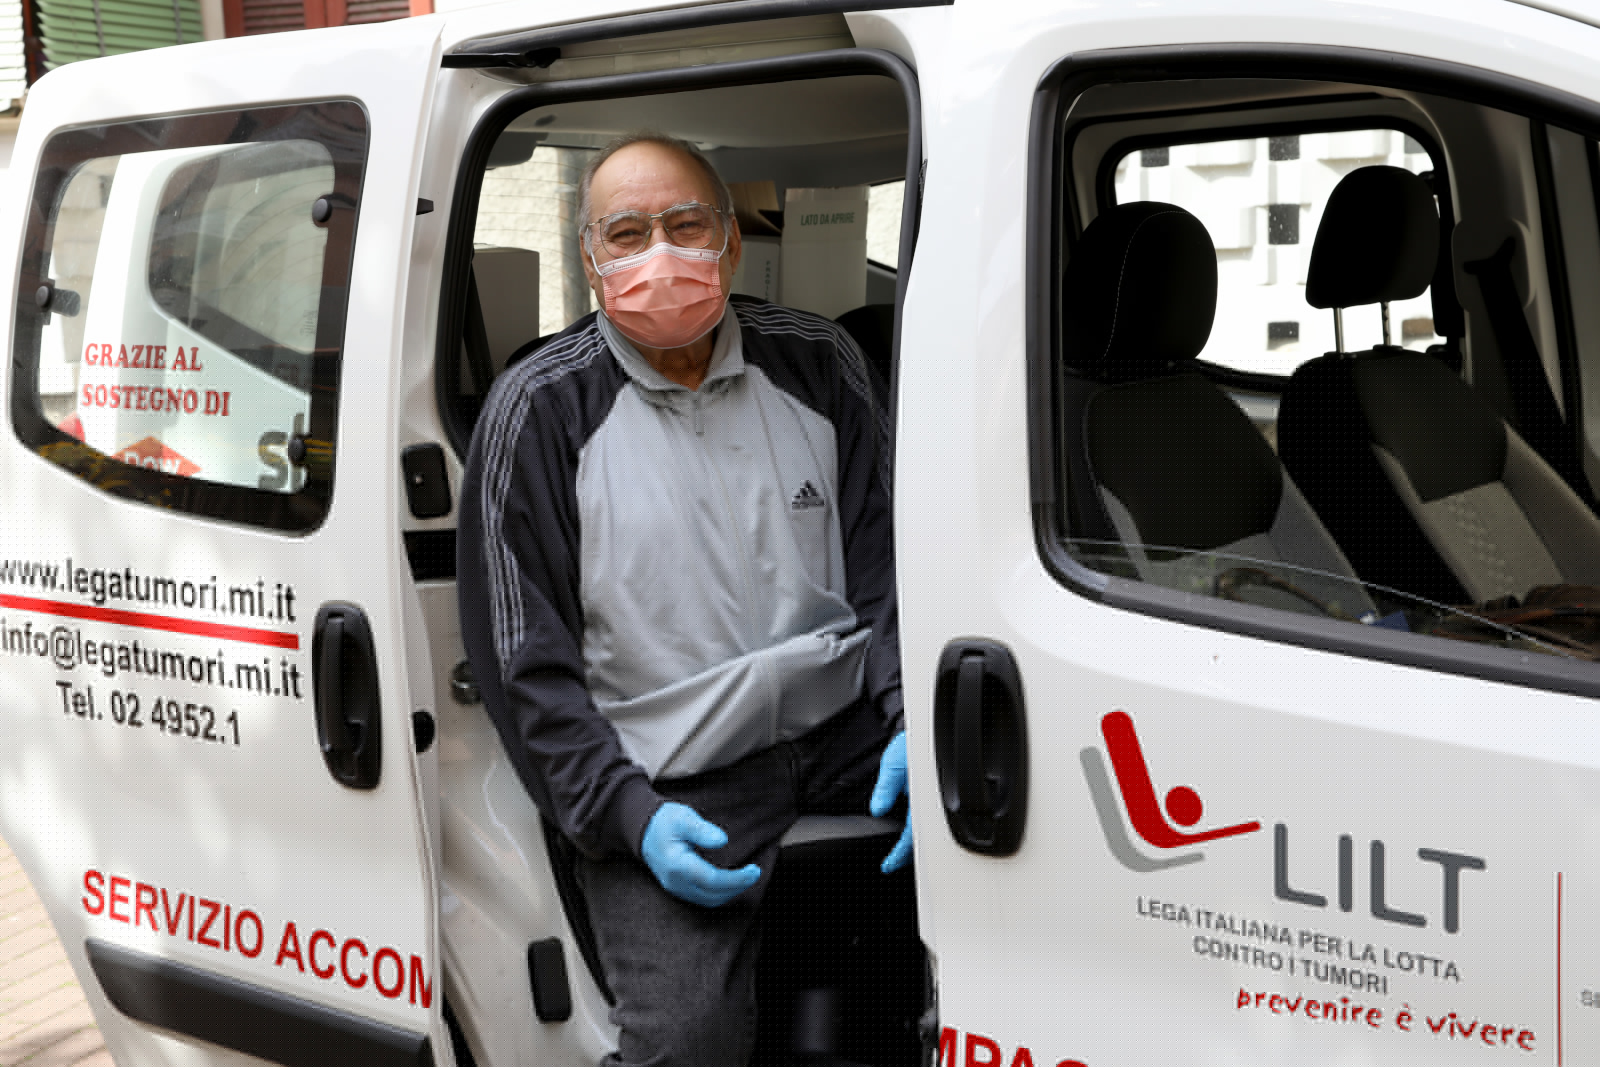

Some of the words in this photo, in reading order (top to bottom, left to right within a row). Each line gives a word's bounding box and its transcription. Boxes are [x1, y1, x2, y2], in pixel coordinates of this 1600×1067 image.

[800, 213, 819, 226] LATO
[820, 213, 830, 225] DA
[831, 211, 855, 225] APRIRE
[84, 342, 167, 369] GRAZIE
[171, 345, 203, 372] AL
[82, 383, 199, 414] SOSTEGNO
[203, 390, 231, 416] DI
[0, 616, 302, 700] info@legatumori.mi.it
[55, 680, 104, 720] Tel.
[110, 690, 144, 728] 02
[151, 696, 241, 746] 4952.1
[1273, 822, 1487, 934] LILT
[82, 869, 264, 958] SERVIZIO
[1136, 895, 1191, 927] LEGA
[1195, 908, 1293, 946] ITALIANA
[1299, 929, 1343, 959] PER
[1349, 940, 1377, 966] LA
[1383, 947, 1461, 984] LOTTA
[1193, 934, 1283, 972] CONTRO
[1288, 956, 1297, 976] I
[1302, 958, 1389, 995] TUMORI
[1236, 987, 1383, 1028] prevenire
[1395, 1003, 1413, 1032] è
[1425, 1012, 1537, 1051] vivere
